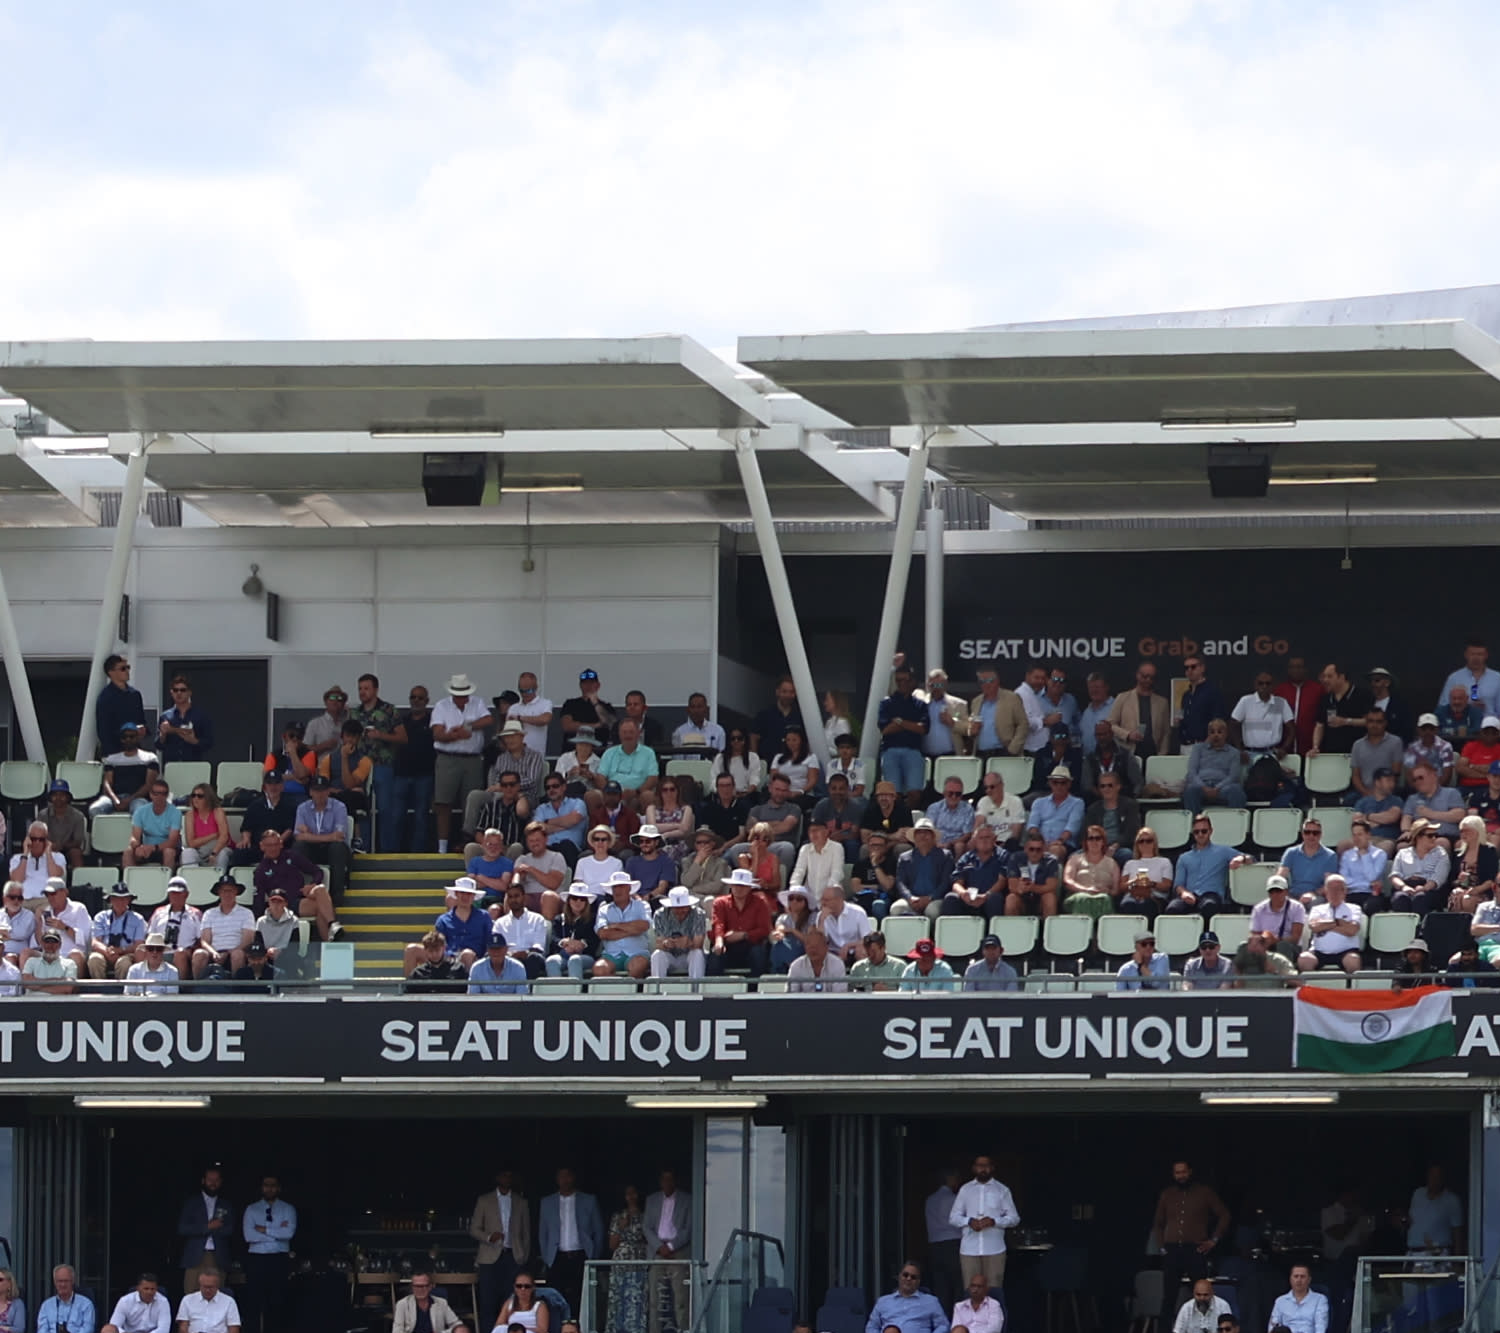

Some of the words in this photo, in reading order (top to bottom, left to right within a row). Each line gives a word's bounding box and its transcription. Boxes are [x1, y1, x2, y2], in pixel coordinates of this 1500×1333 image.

[959, 639, 1024, 660] SEAT
[1028, 637, 1126, 661] UNIQUE
[1137, 636, 1198, 657] Grab
[1203, 636, 1248, 656] and
[1254, 635, 1289, 656] Go
[37, 1020, 244, 1067] UNIQUE
[381, 1021, 521, 1061] SEAT
[534, 1020, 746, 1067] UNIQUE
[883, 1018, 1022, 1059] SEAT
[1036, 1017, 1248, 1064] UNIQUE
